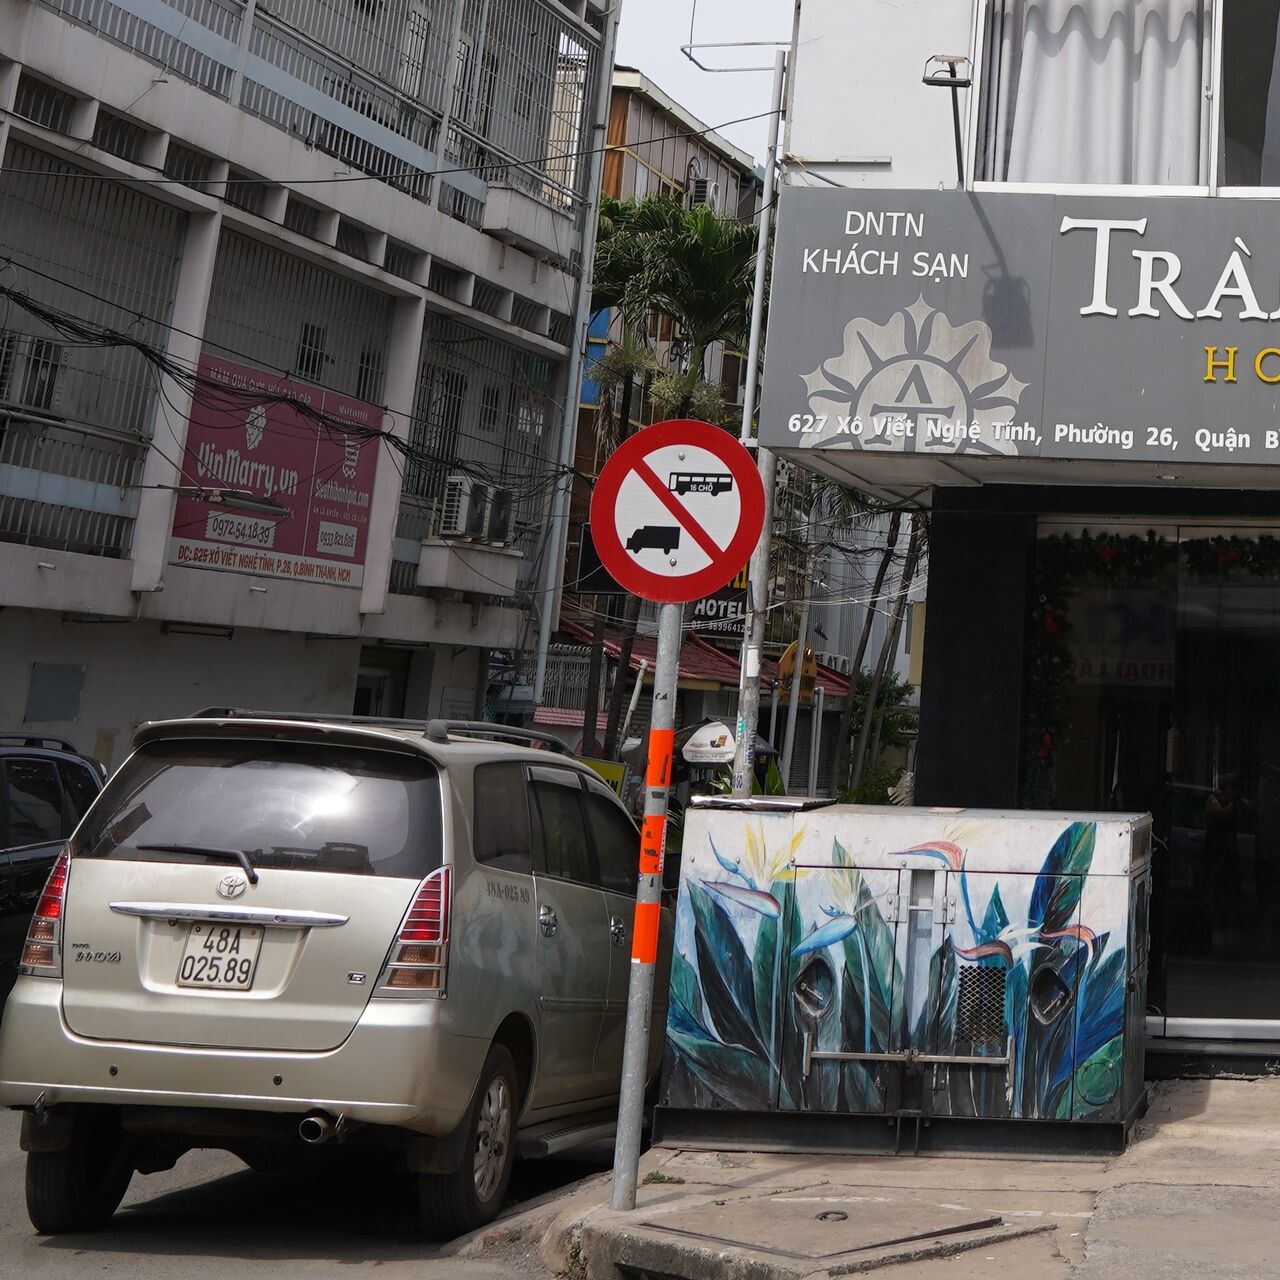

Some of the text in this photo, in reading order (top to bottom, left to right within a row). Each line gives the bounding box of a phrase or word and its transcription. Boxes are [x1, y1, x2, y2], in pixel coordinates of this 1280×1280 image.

[844, 210, 925, 238] DNTN
[801, 242, 970, 284] KHÁCH SẠN
[787, 413, 827, 436] 627
[836, 416, 864, 437] Xô
[872, 413, 914, 440] Viết
[925, 417, 981, 447] Nghệ
[992, 420, 1042, 446] Tĩnh,
[1054, 423, 1134, 450] Phường
[1146, 427, 1178, 451] 26,
[1194, 428, 1251, 453] Quận
[197, 441, 299, 498] VinMarry.vn
[690, 483, 697, 492] 16
[694, 598, 746, 617] HOTEL
[203, 926, 242, 954] 48A
[180, 955, 252, 984] 025.89
